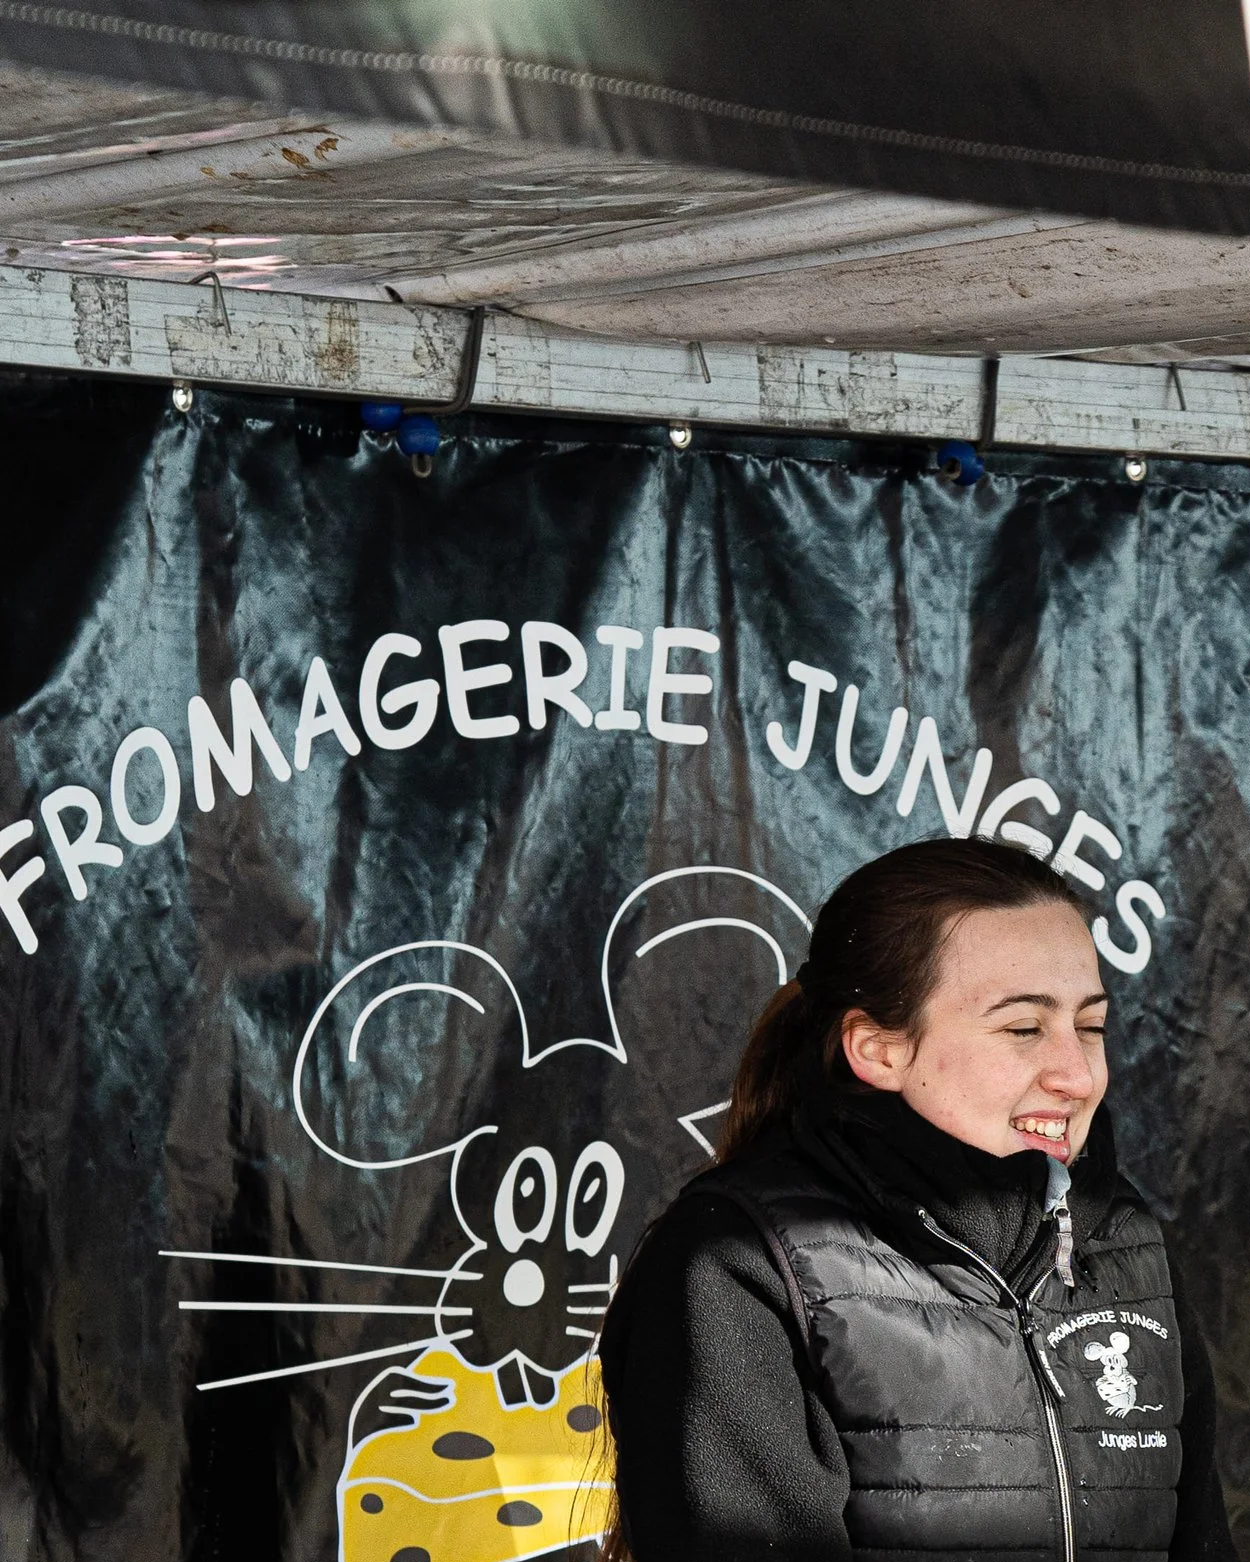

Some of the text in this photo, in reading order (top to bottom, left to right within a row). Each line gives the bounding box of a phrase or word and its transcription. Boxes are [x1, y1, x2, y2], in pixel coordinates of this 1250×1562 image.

[0, 618, 1167, 974] FROMAGERIE JUNGES
[1046, 1310, 1169, 1349] FROMAGERIE JUNGES
[1098, 1431, 1168, 1451] Junges Lucile
